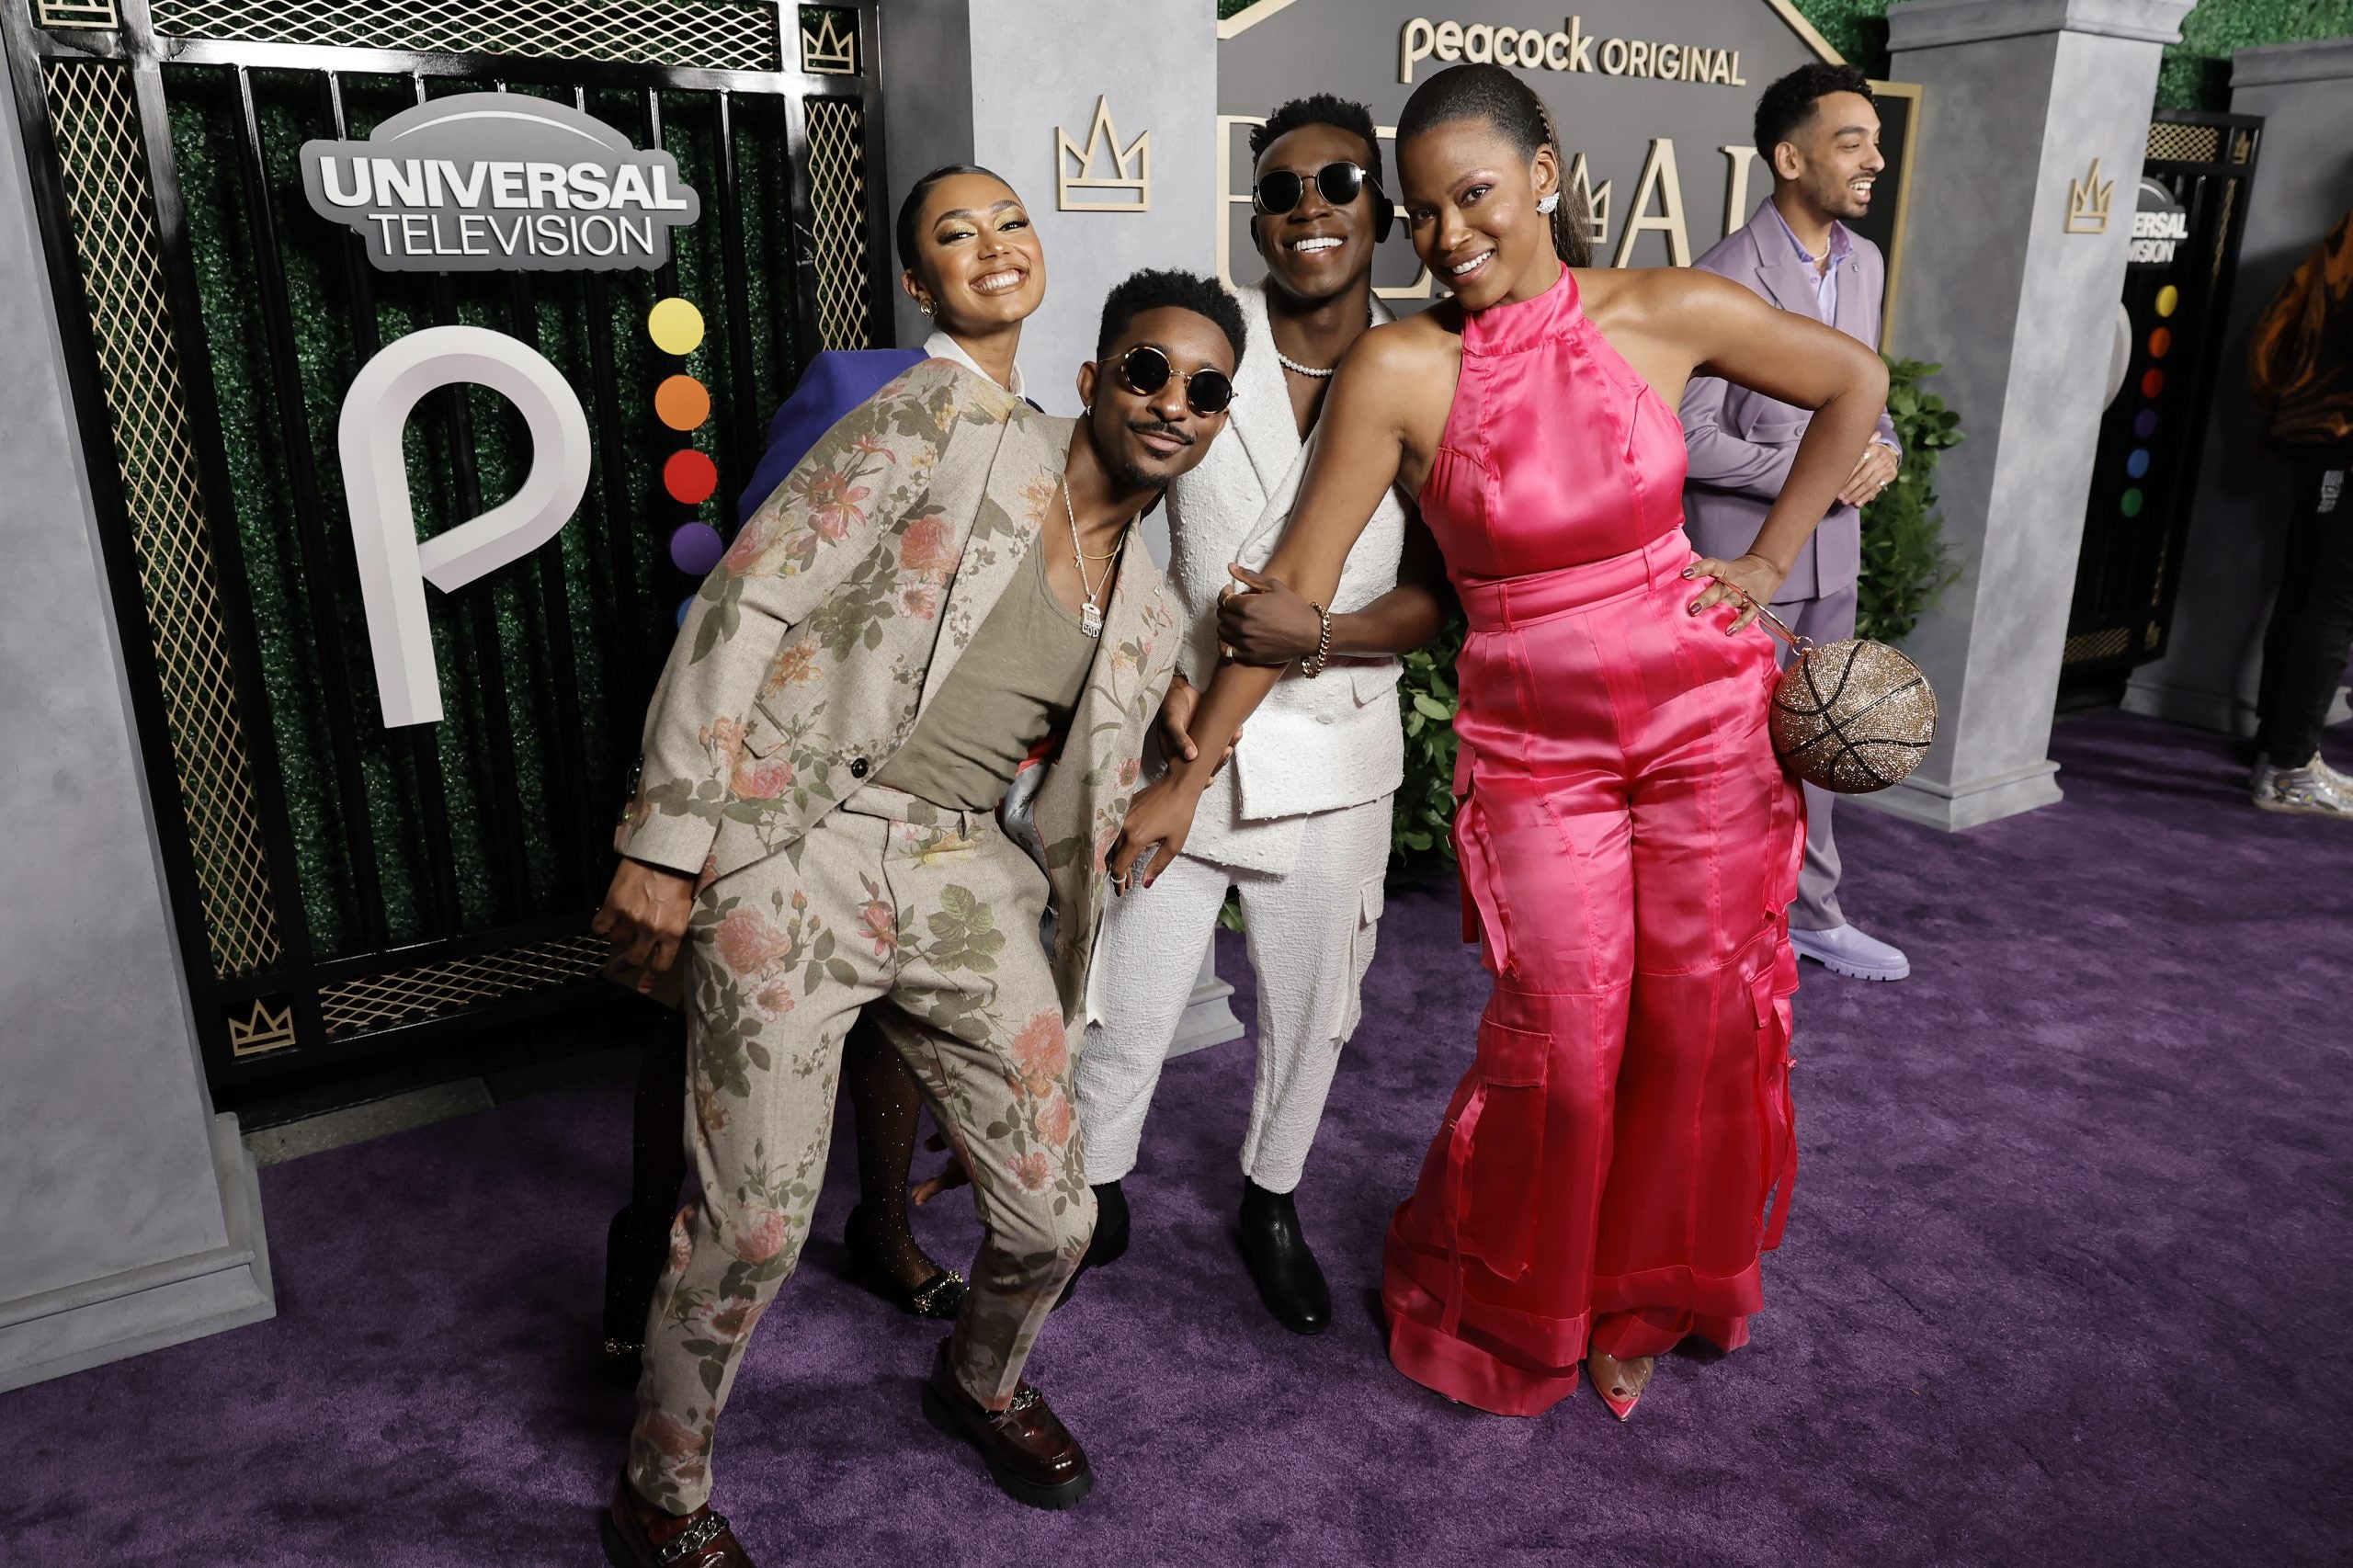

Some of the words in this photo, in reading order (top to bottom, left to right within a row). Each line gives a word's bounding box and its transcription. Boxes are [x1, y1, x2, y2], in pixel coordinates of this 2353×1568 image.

[1402, 15, 1595, 84] peacock
[1601, 38, 1746, 85] ORIGINAL
[320, 156, 688, 210] UNIVERSAL
[368, 213, 654, 256] TELEVISION
[2131, 211, 2188, 239] ERSAL
